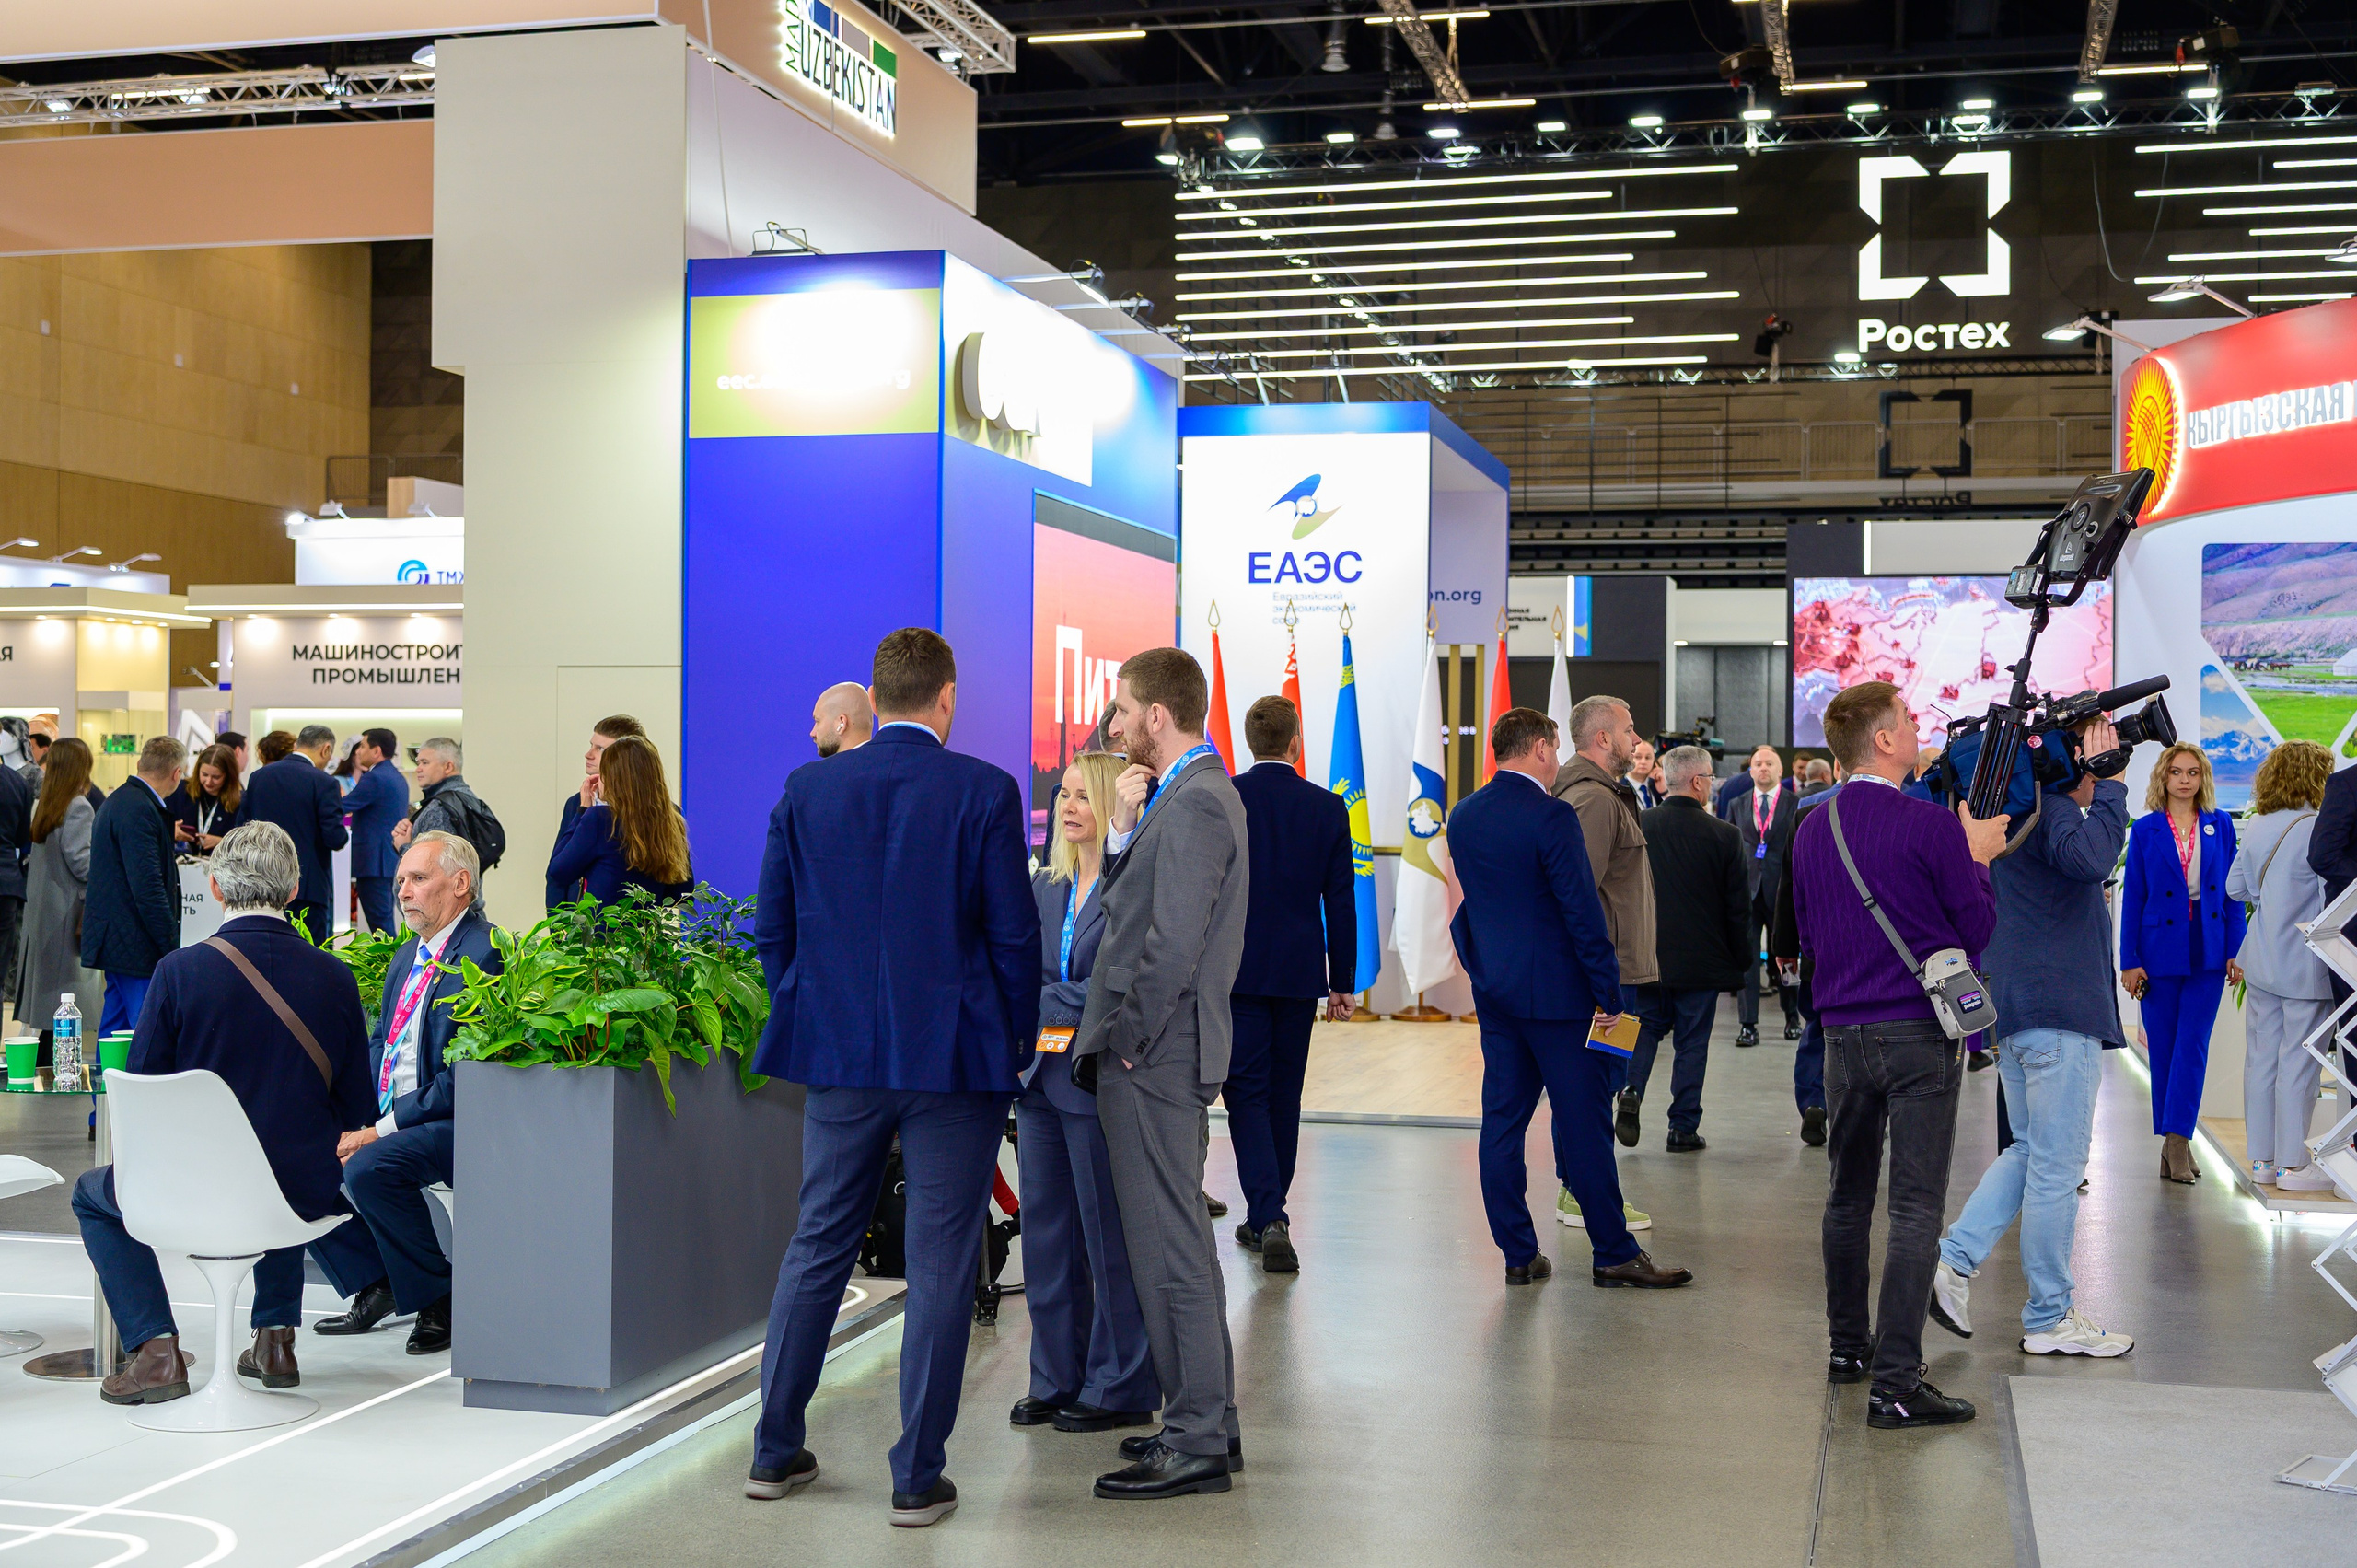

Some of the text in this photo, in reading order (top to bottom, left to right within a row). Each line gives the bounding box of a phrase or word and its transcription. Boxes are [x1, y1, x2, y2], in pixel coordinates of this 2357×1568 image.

[800, 19, 898, 135] UZBEKISTAN
[1858, 318, 2011, 353] Ростех
[2187, 382, 2345, 448] КЫРГЫЗСКАЯ
[1248, 551, 1363, 584] ЕАЭС
[1272, 590, 1343, 603] Евразийский
[313, 668, 460, 685] ПРОМЫШЛЕН
